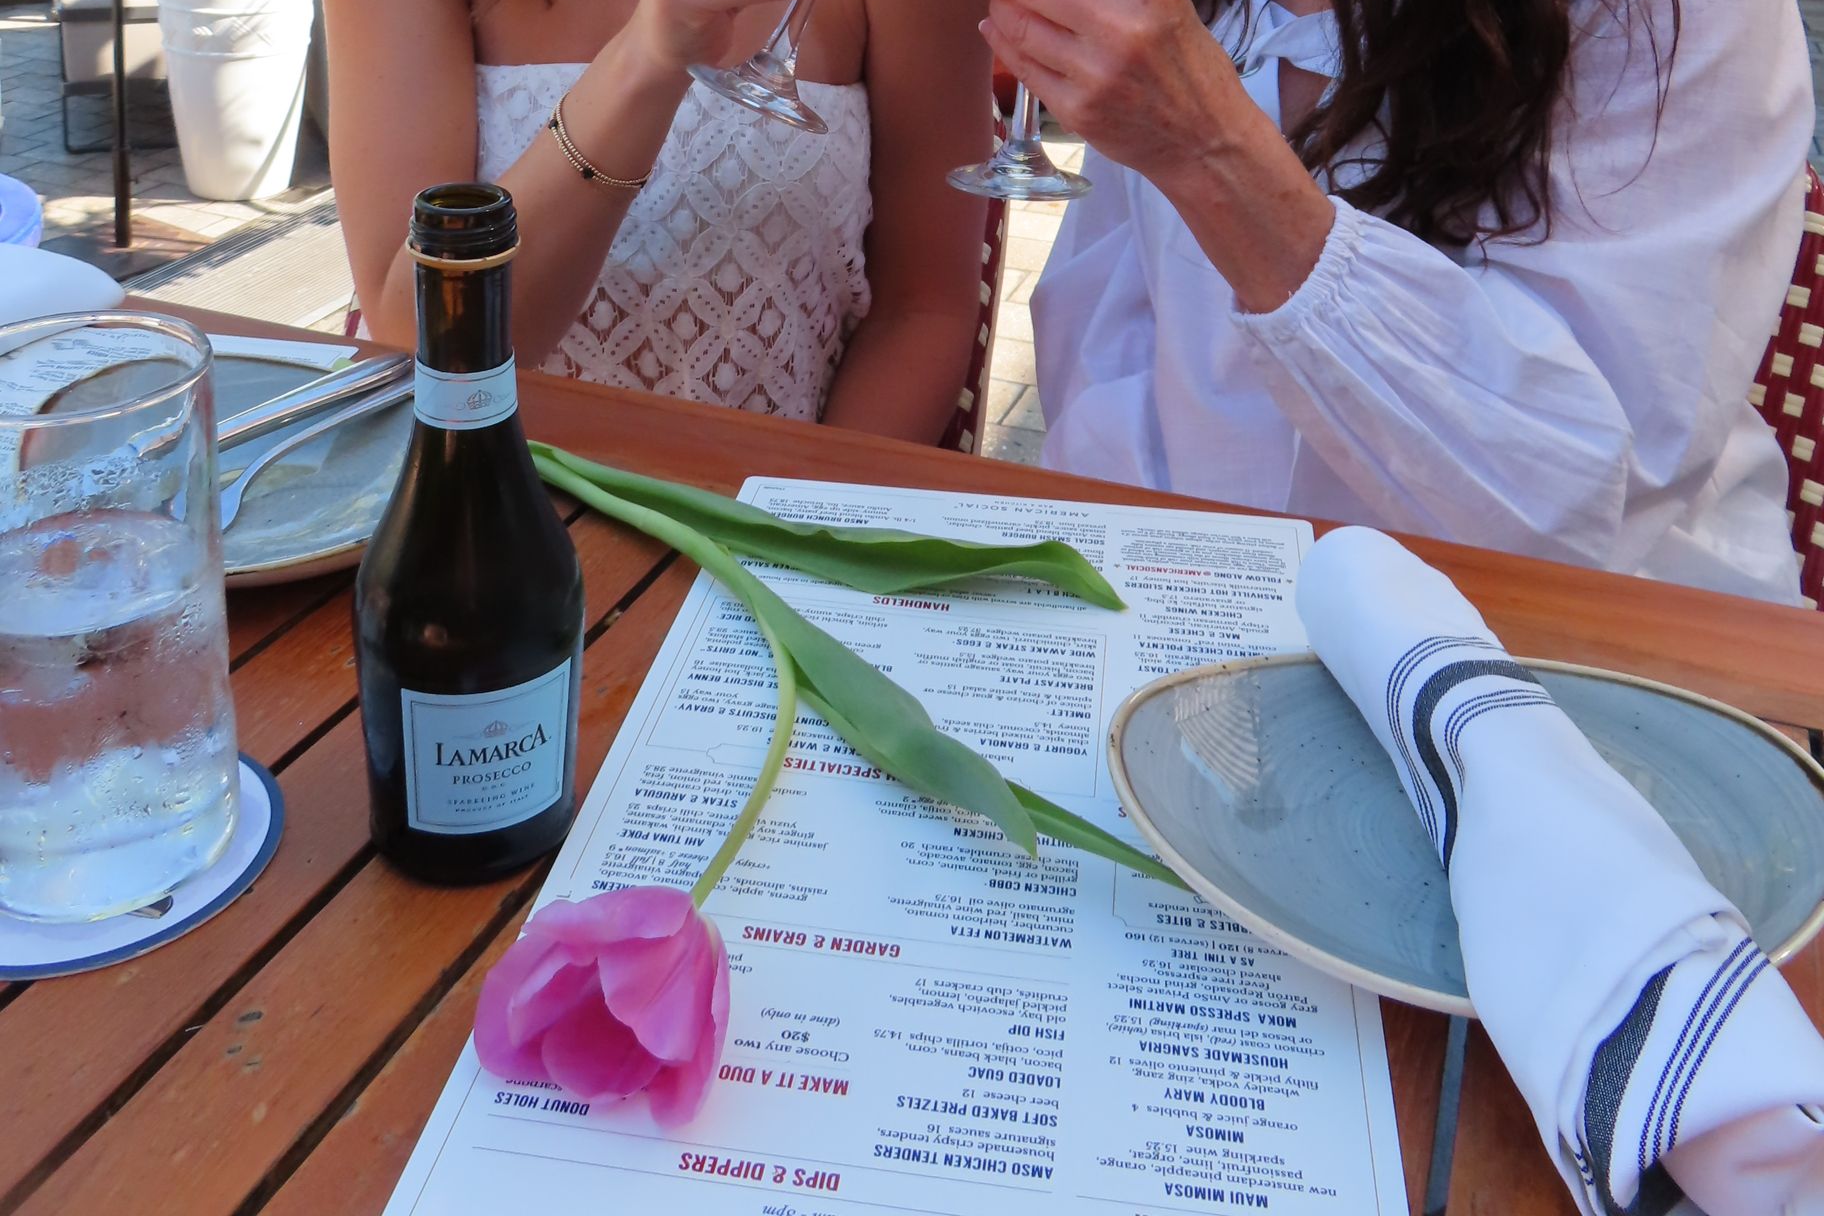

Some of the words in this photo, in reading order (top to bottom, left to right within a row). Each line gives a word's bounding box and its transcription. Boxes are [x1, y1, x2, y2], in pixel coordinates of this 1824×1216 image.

[1012, 507, 1089, 518] AMERICAN
[1039, 534, 1069, 542] SMASH
[1072, 536, 1105, 545] SOCIAL
[1246, 574, 1281, 583] FOLLOW
[1125, 582, 1163, 591] SLIDERS
[1166, 585, 1206, 594] CHICKEN
[1232, 590, 1282, 601] NASHVILLE
[872, 596, 950, 612] HANDHELDS
[1201, 609, 1242, 619] CHICKEN
[1168, 627, 1204, 637] CHEESE
[1218, 632, 1240, 640] MAC
[996, 642, 1027, 652] STEAK
[1030, 646, 1066, 656] AWAKE
[1070, 649, 1096, 658] WIDE
[1139, 641, 1183, 652] POLENTA
[1186, 645, 1223, 655] CHEESE
[1137, 665, 1169, 674] TOAST
[688, 673, 721, 684] BENNY
[724, 675, 764, 688] BISCUIT
[1000, 676, 1031, 685] PLATE
[1034, 678, 1094, 691] BREAKFAST
[729, 708, 776, 721] BISCUITS
[980, 738, 1029, 750] GRANOLA
[1033, 744, 1040, 752] &
[1046, 745, 1088, 756] YOGURT
[453, 761, 532, 784] PROSECCO
[783, 756, 882, 780] SPECIALTIES
[635, 787, 686, 805] ARUGULA
[690, 796, 698, 806] &
[702, 795, 738, 809] STEAK
[654, 832, 681, 845] TUNA
[684, 835, 705, 847] AHI
[954, 828, 1004, 840] CHICKEN
[1024, 882, 1076, 897] CHICKEN
[1156, 914, 1191, 926] BITES
[1196, 918, 1204, 927] &
[741, 928, 807, 946] GRAINS
[950, 926, 980, 938] FETA
[984, 929, 1072, 949] WATERMELON
[814, 935, 826, 949] &
[831, 937, 900, 958] GARDEN
[1171, 948, 1198, 960] TREE
[1204, 952, 1225, 964] TINI
[1230, 956, 1236, 965] A
[1240, 956, 1254, 966] AS
[889, 994, 954, 1011] vegetables,
[1129, 998, 1186, 1014] MARTINI
[761, 1007, 791, 1020] only)
[794, 1013, 806, 1022] in
[958, 1004, 1014, 1018] escovitch
[1018, 1010, 1042, 1023] bay,
[1190, 1004, 1250, 1023] SPRESSO
[809, 1014, 841, 1028] (dine
[1046, 1014, 1066, 1025] old
[1258, 1014, 1296, 1028] MOKA
[781, 1028, 810, 1043] $20
[874, 1028, 902, 1040] 14.75
[1008, 1024, 1031, 1037] DIP
[1035, 1027, 1064, 1041] FISH
[734, 1037, 761, 1048] two
[910, 1032, 942, 1046] chips
[946, 1038, 988, 1052] tortilla
[766, 1041, 792, 1054] any
[796, 1046, 850, 1062] Choose
[905, 1042, 938, 1056] corn,
[940, 1047, 980, 1062] beans,
[992, 1042, 1029, 1056] cotija,
[1032, 1046, 1063, 1060] pico,
[1139, 1040, 1199, 1058] SANGRIA
[984, 1053, 1017, 1068] black
[1020, 1056, 1062, 1071] bacon,
[1110, 1056, 1121, 1065] 12
[1129, 1058, 1164, 1071] olives
[1204, 1048, 1288, 1070] HOUSEMADE
[718, 1064, 756, 1083] DUO
[968, 1066, 1004, 1081] GUAC
[1168, 1062, 1226, 1078] pimiento
[1230, 1071, 1240, 1080] &
[762, 1070, 772, 1085] A
[776, 1072, 794, 1087] IT
[1008, 1072, 1061, 1088] LOADED
[1168, 1072, 1194, 1085] zing
[1198, 1077, 1239, 1089] vodka,
[1244, 1072, 1281, 1085] pickle
[1285, 1076, 1318, 1090] filthy
[800, 1074, 849, 1096] MAKE
[1244, 1082, 1300, 1096] wheatley
[494, 1090, 539, 1110] HOLES
[962, 1089, 976, 1098] 12
[983, 1091, 1026, 1105] cheese
[1164, 1087, 1204, 1104] MARY
[541, 1098, 590, 1117] DONUT
[896, 1096, 967, 1116] PRETZELS
[1029, 1098, 1059, 1109] beer
[1132, 1104, 1139, 1112] 4
[1210, 1092, 1265, 1111] BLOODY
[972, 1105, 1018, 1123] BAKED
[1022, 1111, 1058, 1128] SOFT
[1146, 1105, 1198, 1120] bubbles
[1202, 1112, 1213, 1121] &
[1218, 1113, 1250, 1128] juice
[1252, 1116, 1298, 1132] orange
[927, 1124, 941, 1133] 16
[949, 1126, 990, 1138] sauces
[1186, 1125, 1244, 1144] MIMOSA
[877, 1128, 930, 1144] tenders,
[933, 1134, 974, 1150] crispy
[994, 1131, 1056, 1148] signature
[977, 1142, 1054, 1161] housemade
[1146, 1141, 1178, 1153] 15.25
[1186, 1146, 1218, 1157] wine
[874, 1144, 938, 1165] TENDERS
[1128, 1149, 1175, 1164] orgeat,
[1222, 1148, 1286, 1166] sparkling
[678, 1152, 766, 1181] DIPPERS
[944, 1154, 1007, 1174] CHICKEN
[1096, 1157, 1146, 1173] orange,
[1178, 1156, 1214, 1169] lime,
[772, 1165, 786, 1184] &
[1012, 1162, 1054, 1179] AMSO
[1150, 1164, 1222, 1182] pineapple,
[1218, 1160, 1304, 1180] passionfruit,
[793, 1167, 841, 1192] DIPS
[1226, 1175, 1304, 1193] amsterdam
[1164, 1182, 1224, 1202] MIMOSA
[1309, 1186, 1336, 1196] new
[1230, 1191, 1268, 1208] MAUI
